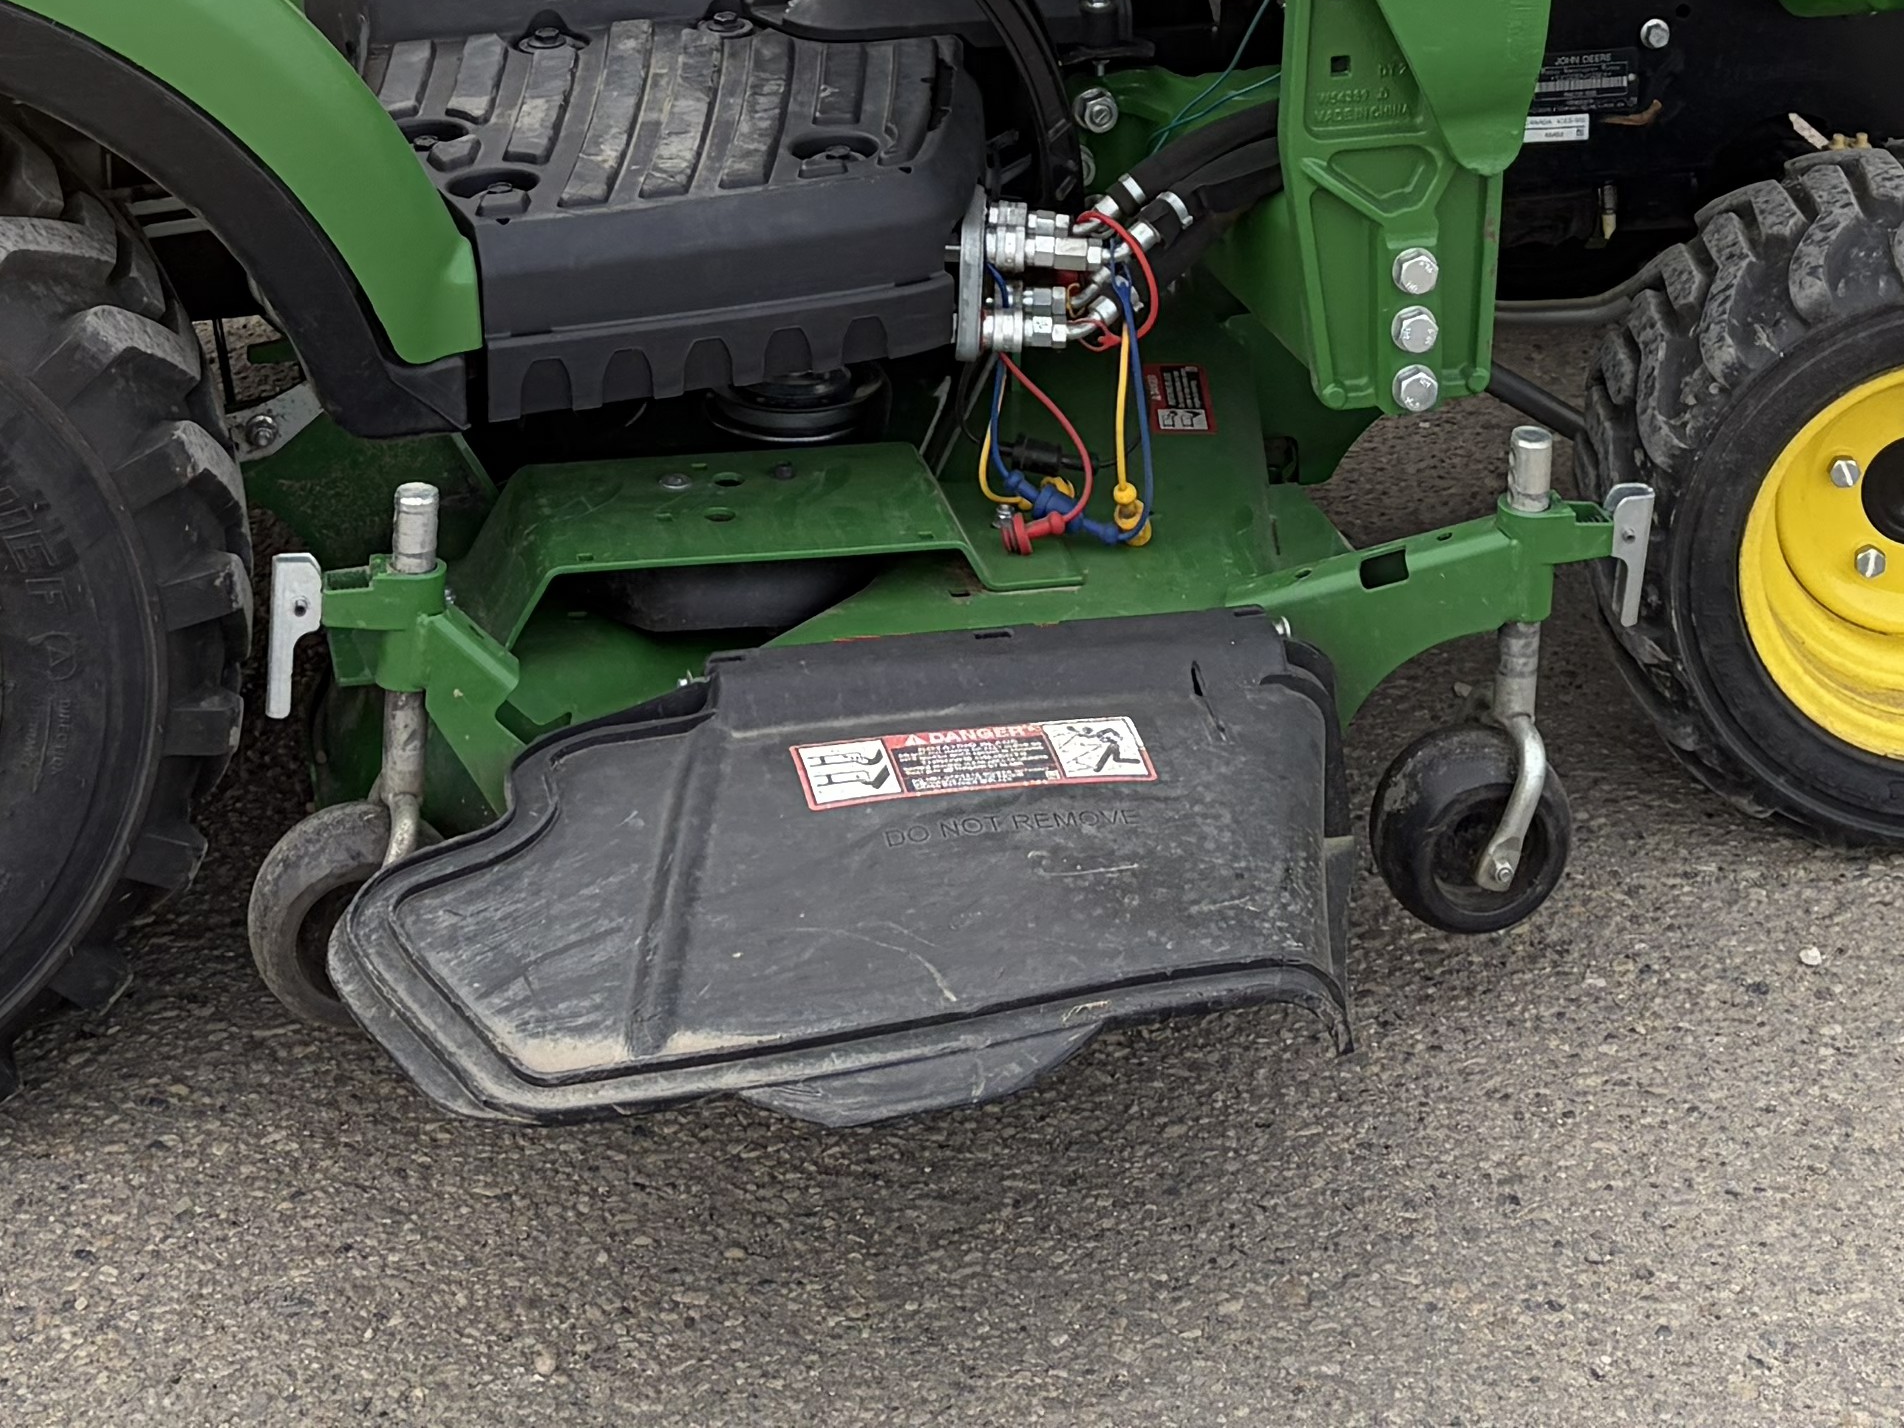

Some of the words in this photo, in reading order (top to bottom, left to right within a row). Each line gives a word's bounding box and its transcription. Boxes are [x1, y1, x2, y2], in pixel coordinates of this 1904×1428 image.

[928, 725, 1025, 744] DANGER
[883, 825, 930, 848] DO
[940, 815, 1002, 839] NOT
[1013, 809, 1141, 830] REMOVE
